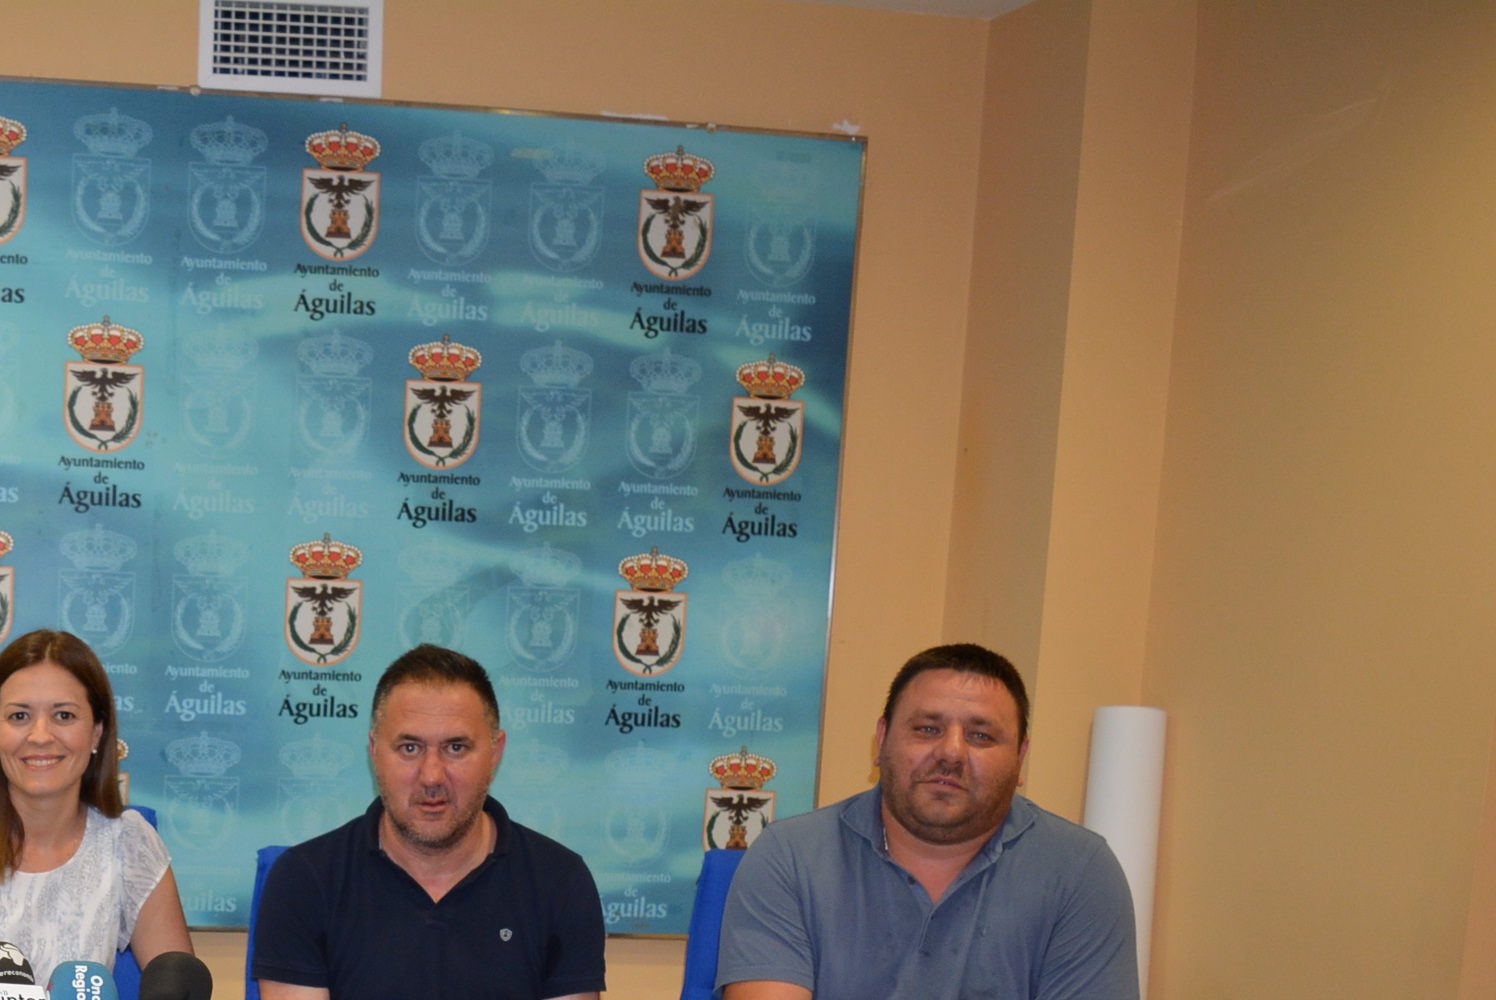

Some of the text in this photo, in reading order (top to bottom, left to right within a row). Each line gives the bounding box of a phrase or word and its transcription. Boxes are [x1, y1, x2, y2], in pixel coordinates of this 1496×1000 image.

[295, 262, 379, 278] Ayuntamiento
[65, 275, 148, 307] Águilas
[329, 278, 344, 291] de
[630, 281, 711, 297] Ayuntamiento
[181, 282, 263, 315] Águilas
[663, 297, 678, 310] de
[736, 288, 816, 304] Ayuntamiento
[295, 289, 376, 321] Águilas
[408, 294, 488, 327] Águilas
[768, 304, 782, 317] de
[520, 301, 599, 333] Águilas
[630, 307, 708, 339] Águilas
[735, 314, 812, 346] Águilas
[58, 455, 144, 471] Ayuntamiento
[173, 462, 258, 477] Ayuntamiento
[93, 471, 108, 484] de
[208, 477, 223, 490] de
[398, 471, 480, 487] Ayuntamiento
[509, 476, 591, 491] Ayuntamiento
[431, 487, 446, 499] de
[618, 481, 699, 496] Ayuntamiento
[723, 486, 802, 501] Ayuntamiento
[59, 482, 141, 513] Águilas
[174, 488, 255, 520] Águilas
[542, 491, 557, 504] de
[651, 496, 665, 509] de
[288, 492, 368, 523] Águilas
[397, 497, 476, 529] Águilas
[755, 502, 769, 514] de
[509, 501, 587, 533] Águilas
[618, 507, 695, 537] Águilas
[722, 512, 798, 543] Águilas
[166, 665, 249, 680] Ayuntamiento
[279, 669, 361, 684] Ayuntamiento
[200, 680, 215, 692] de
[312, 684, 327, 696] de
[605, 679, 685, 694] Ayuntamiento
[709, 683, 788, 697] Ayuntamiento
[166, 691, 246, 721] Águilas
[638, 694, 652, 706] de
[741, 697, 755, 709] de
[278, 694, 358, 725] Águilas
[498, 700, 575, 731] Águilas
[604, 704, 681, 734] Águilas
[708, 708, 784, 737] Águilas
[624, 885, 638, 897] de
[186, 889, 237, 912] uilas
[602, 896, 667, 924] guilas
